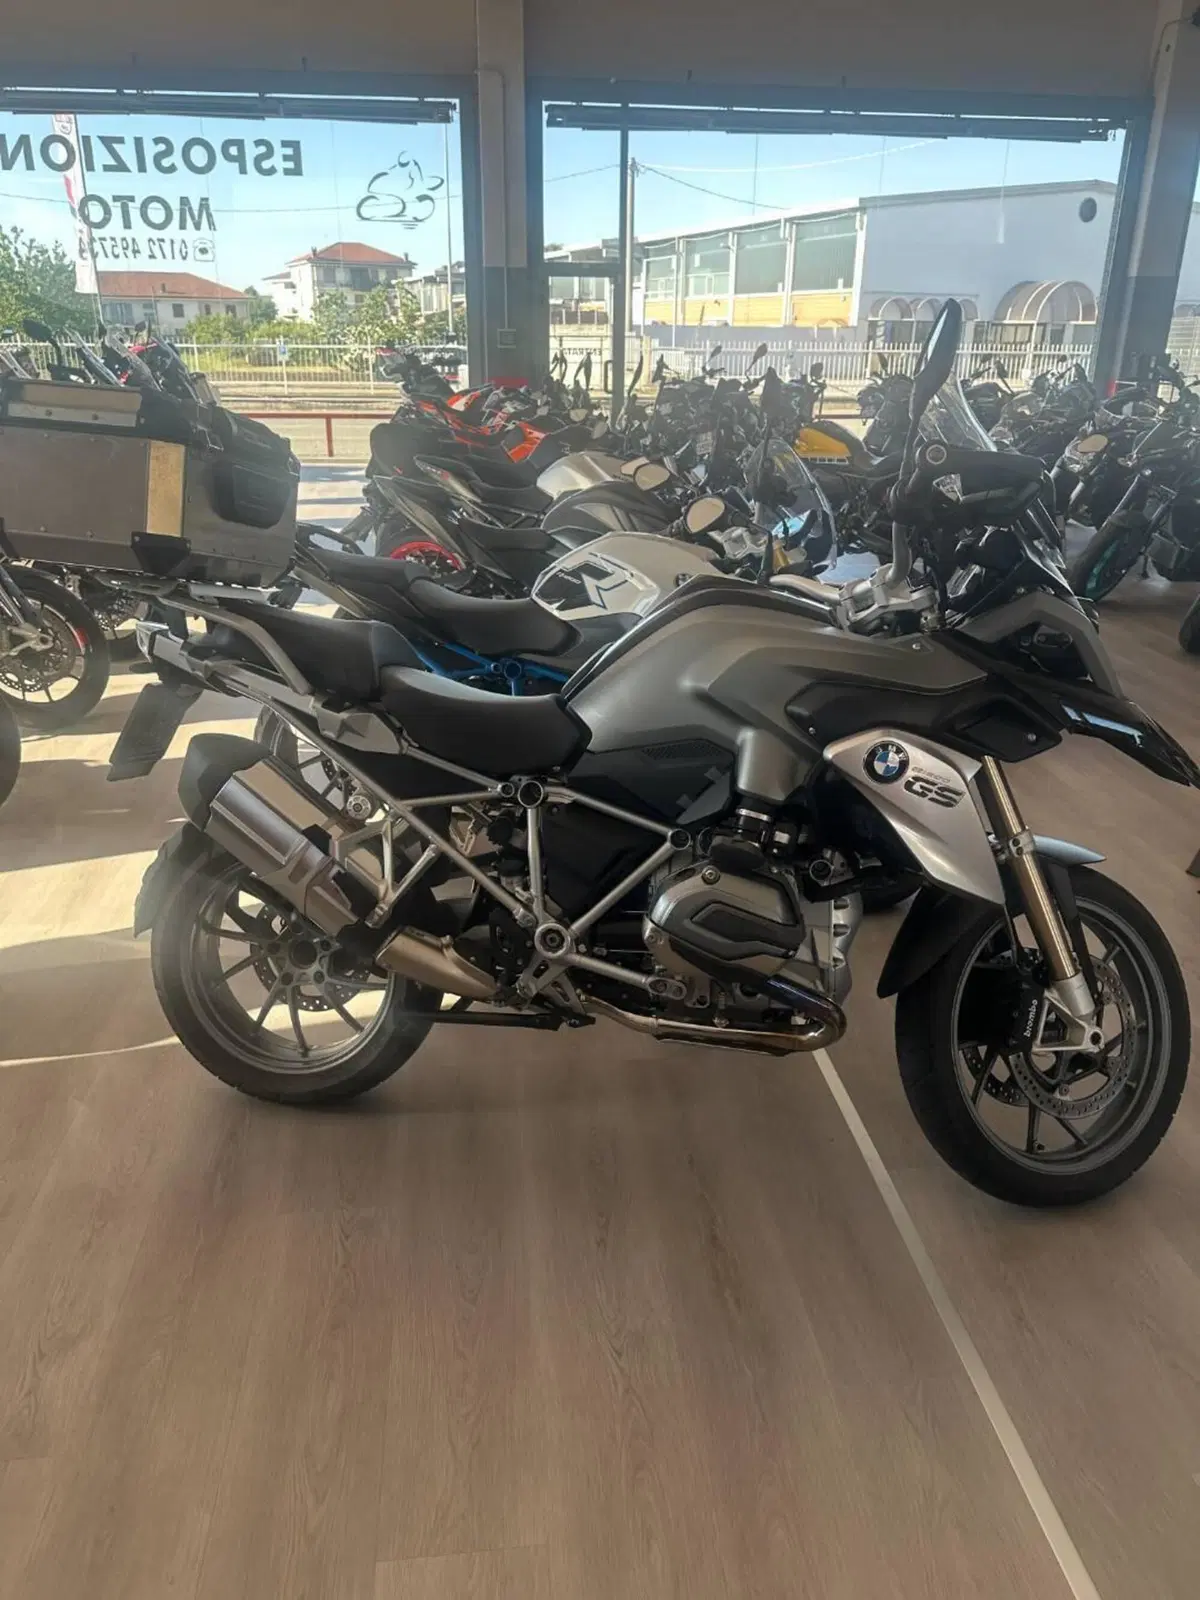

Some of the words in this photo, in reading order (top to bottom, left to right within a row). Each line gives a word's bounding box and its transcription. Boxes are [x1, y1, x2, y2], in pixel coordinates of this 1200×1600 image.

[875, 744, 906, 761] BMW
[904, 776, 965, 808] GS
[1023, 999, 1037, 1037] brembo
